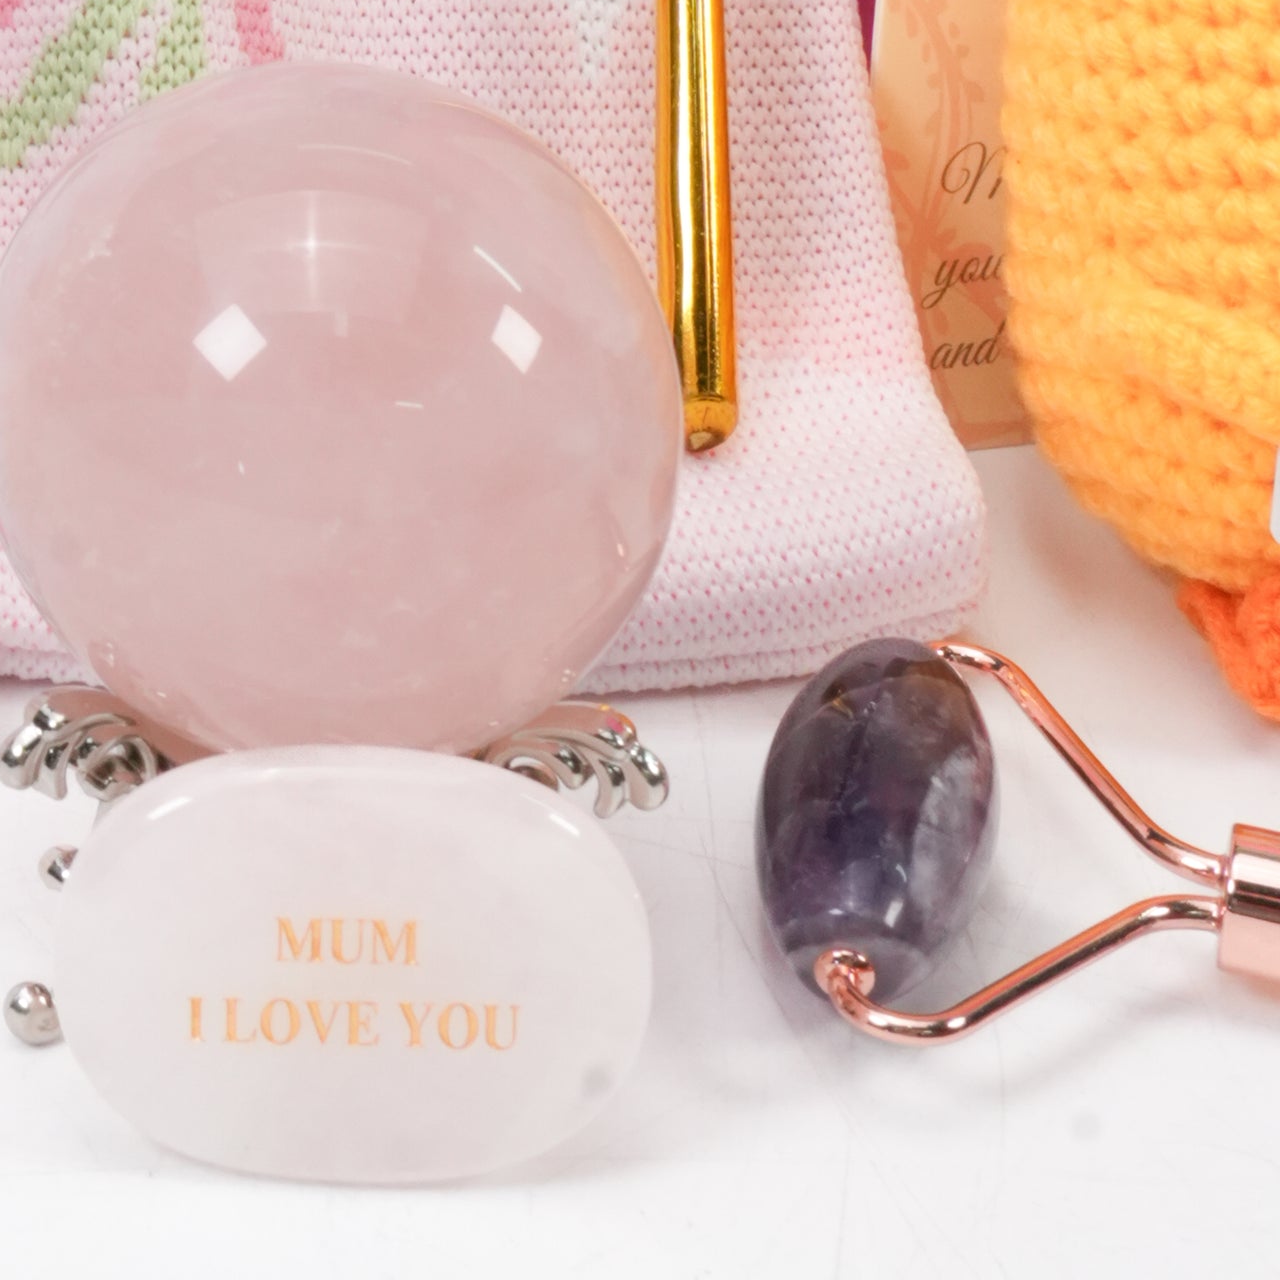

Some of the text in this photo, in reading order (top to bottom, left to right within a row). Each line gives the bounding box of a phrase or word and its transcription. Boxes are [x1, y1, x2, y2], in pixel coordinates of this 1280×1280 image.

[275, 917, 419, 965] MUM
[188, 997, 521, 1051] I LOVE YOU
